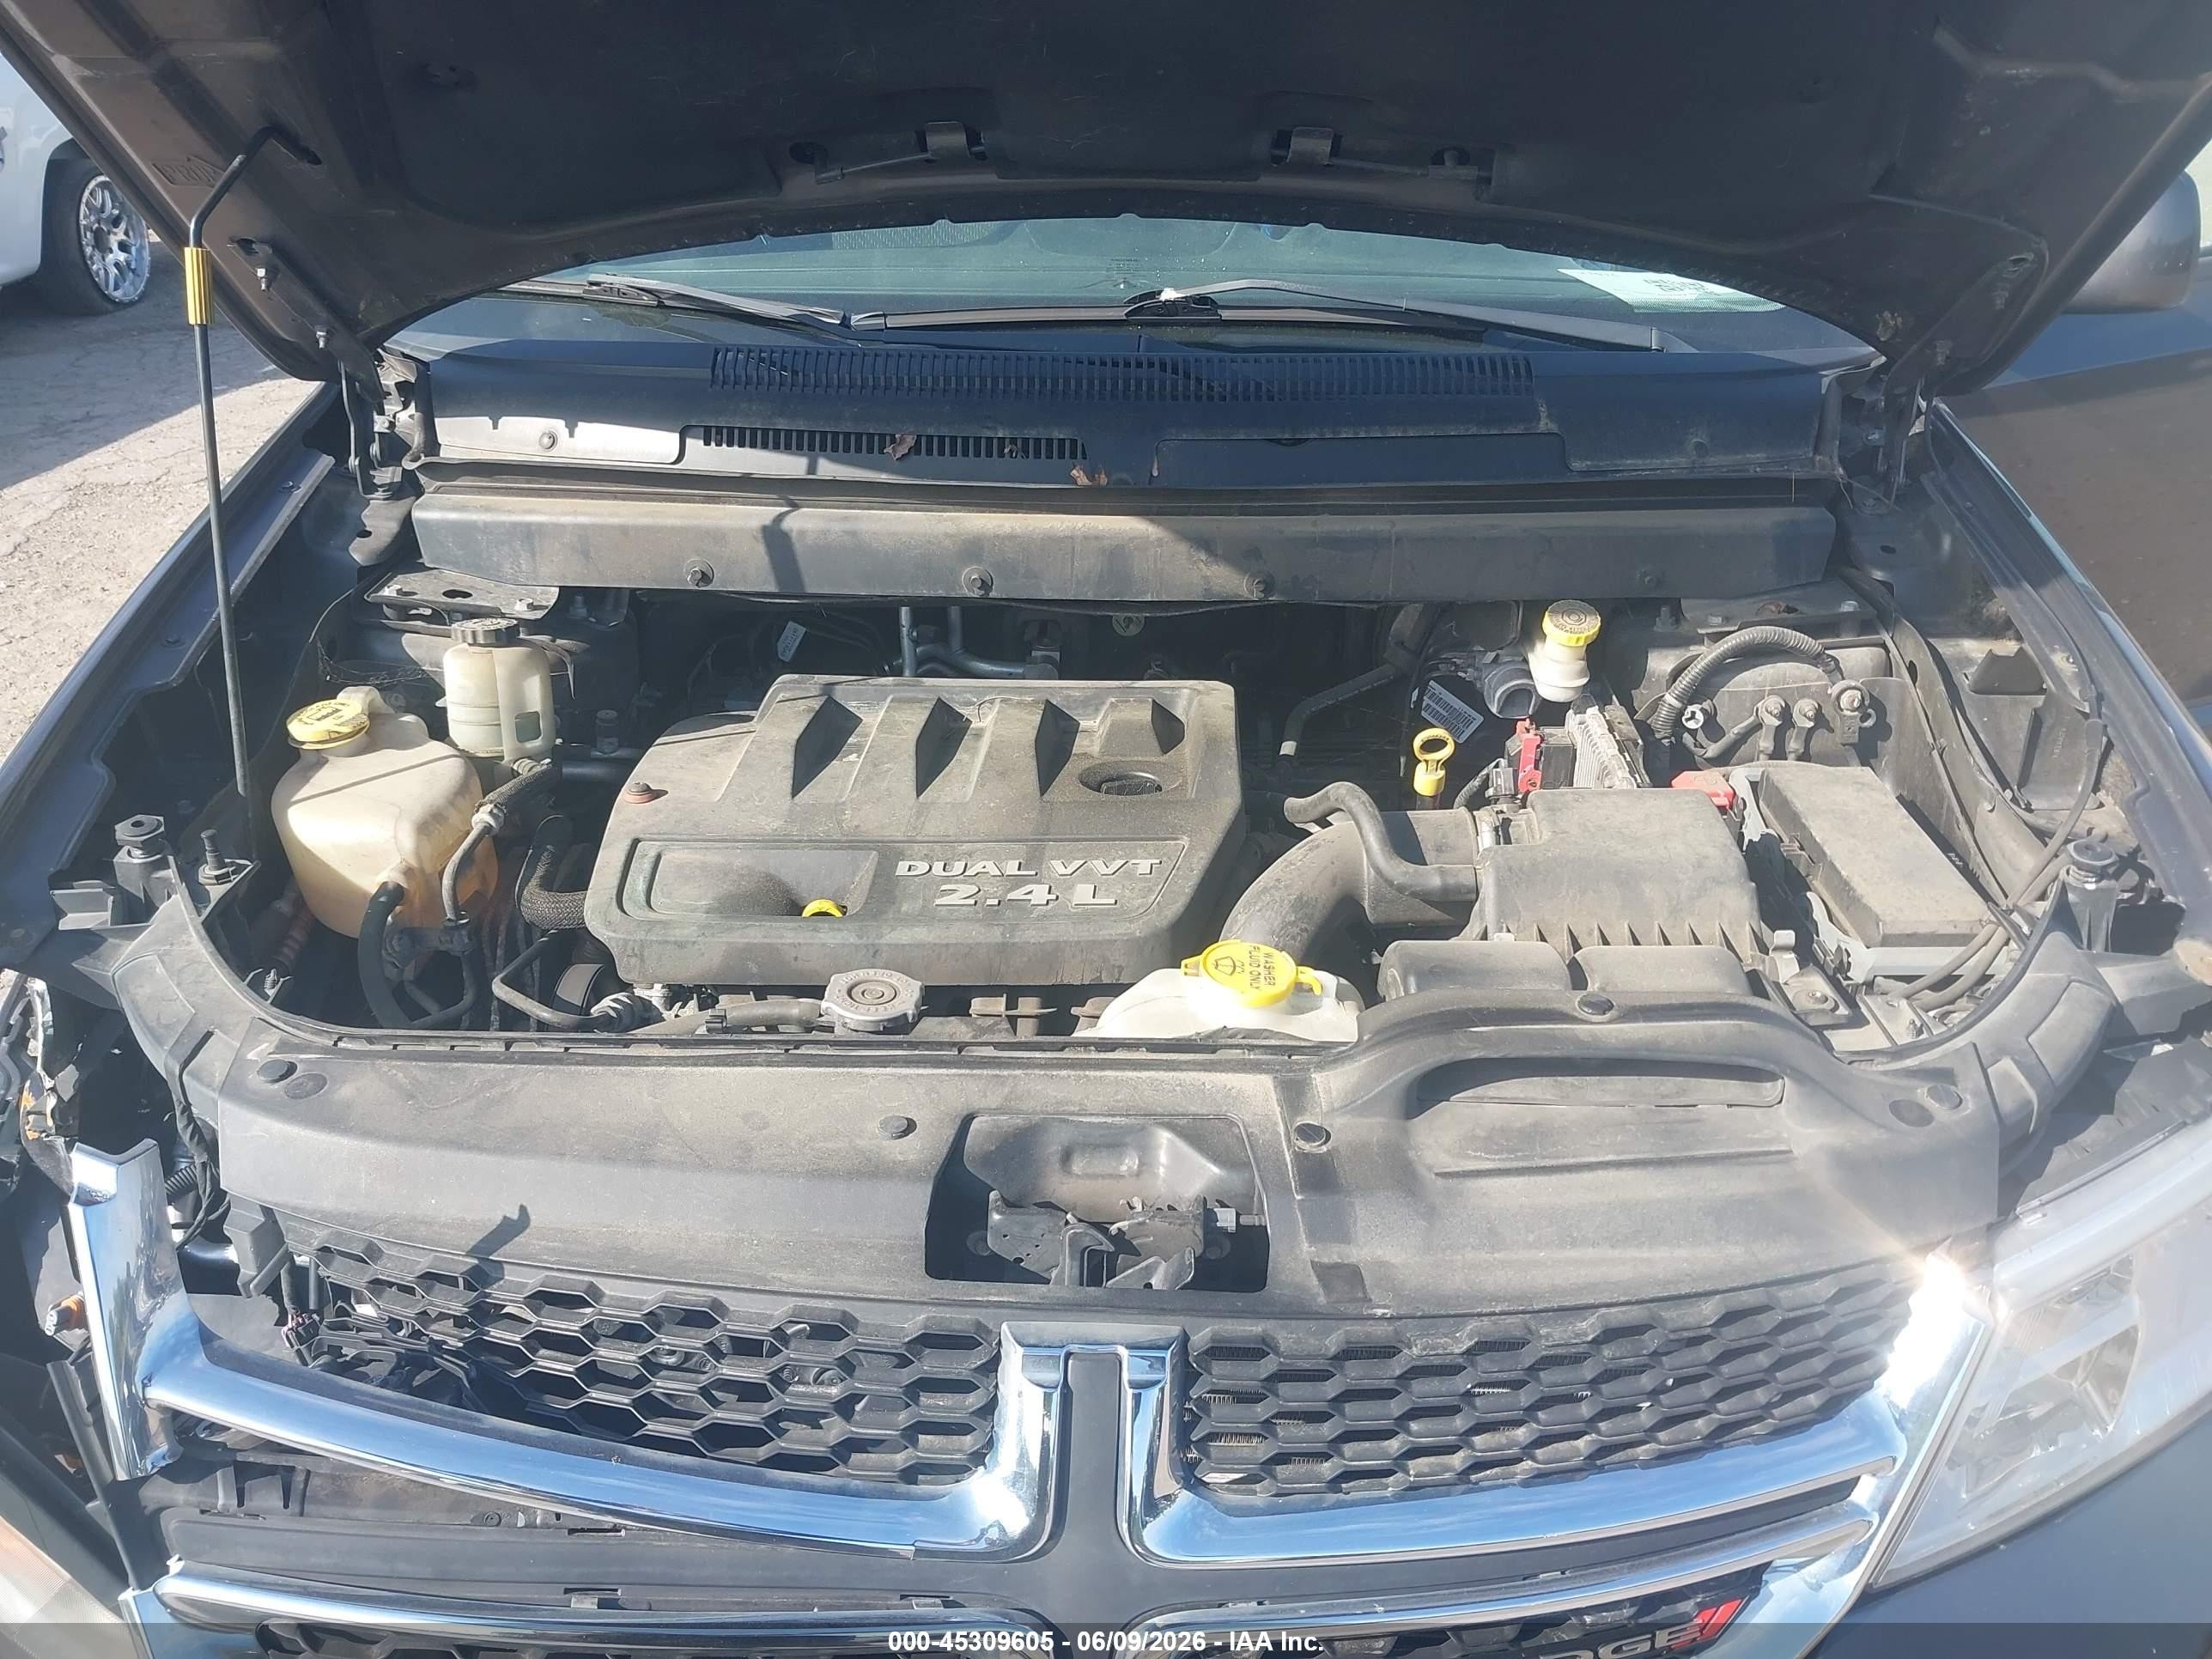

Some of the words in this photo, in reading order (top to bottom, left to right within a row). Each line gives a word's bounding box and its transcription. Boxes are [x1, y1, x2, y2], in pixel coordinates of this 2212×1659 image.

[895, 859, 1038, 878] DUAL
[1048, 860, 1163, 877] VVT
[933, 883, 1119, 908] 2.4L
[1249, 945, 1261, 968] FLUID
[1249, 970, 1261, 990] ONLY
[1263, 952, 1276, 986] WASHER
